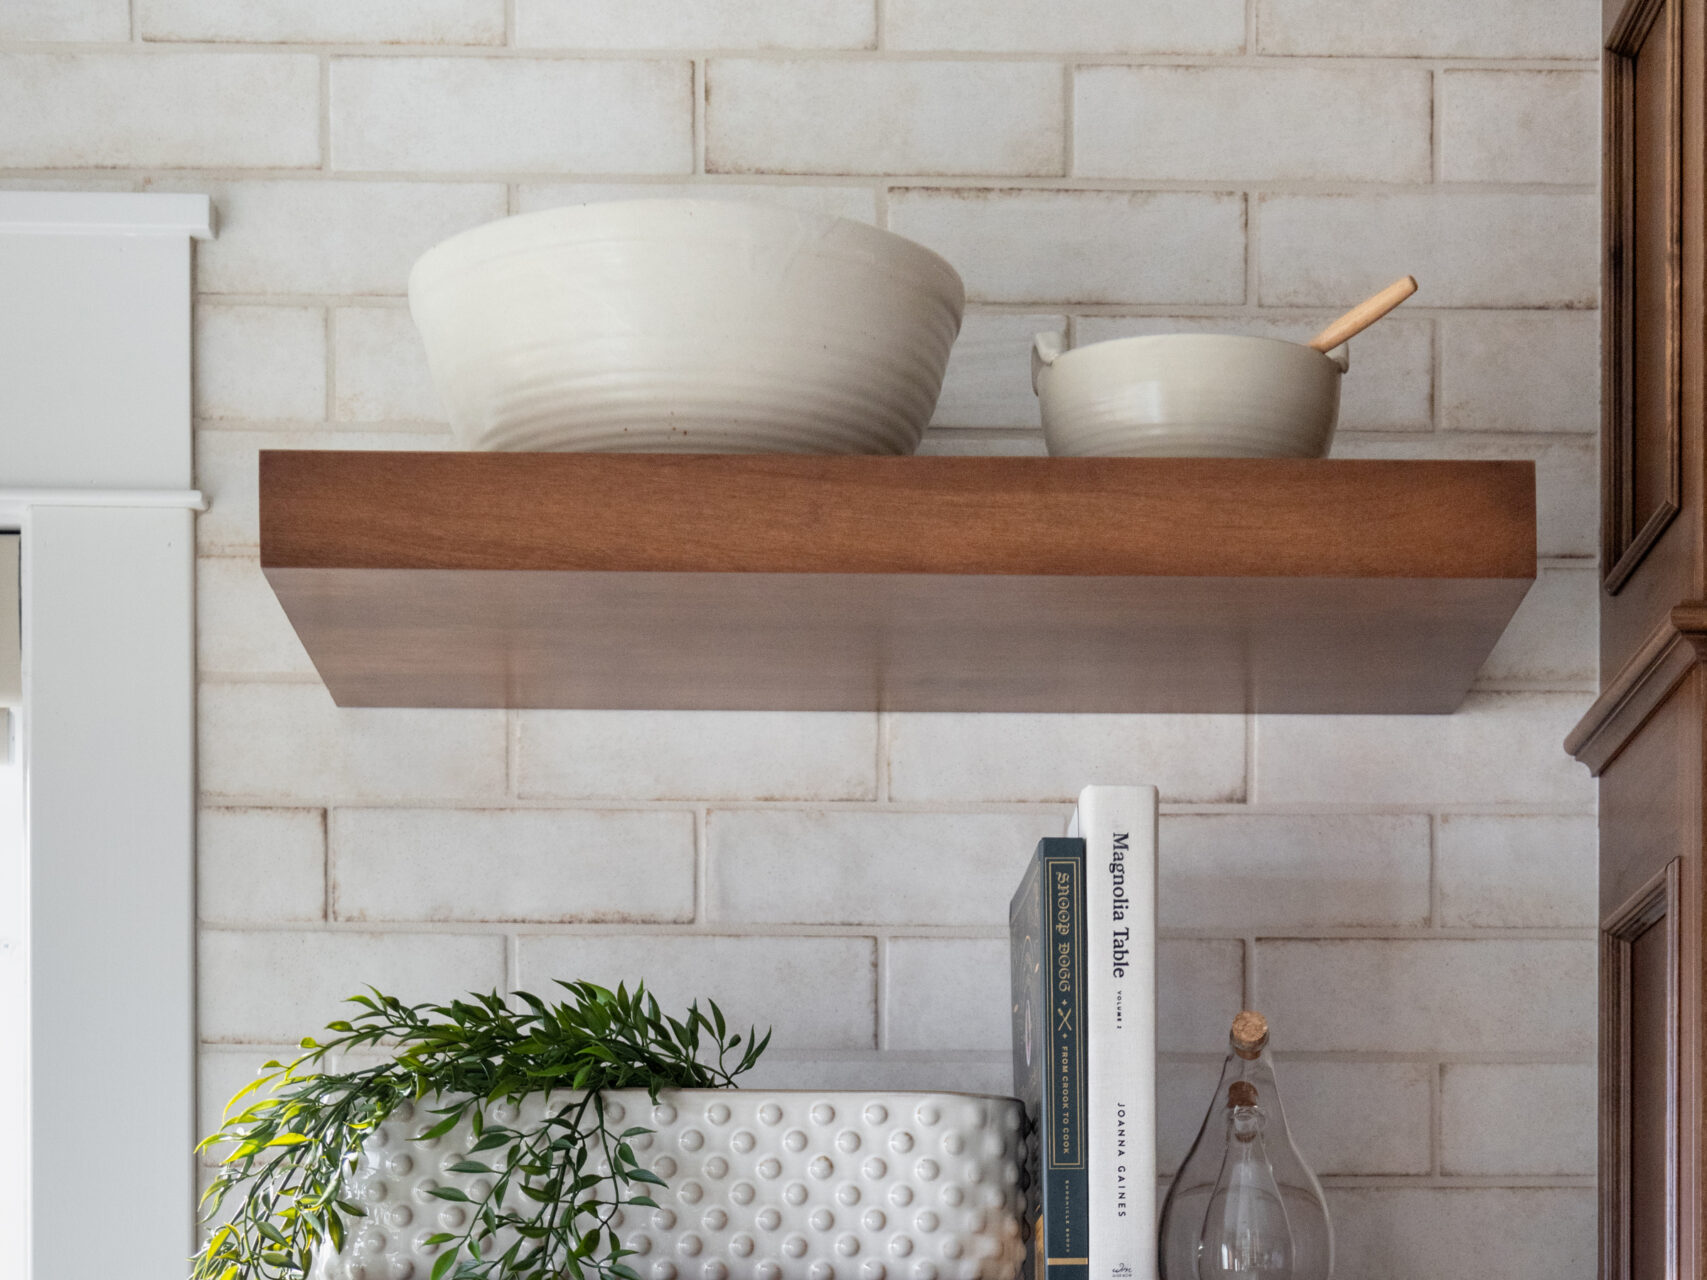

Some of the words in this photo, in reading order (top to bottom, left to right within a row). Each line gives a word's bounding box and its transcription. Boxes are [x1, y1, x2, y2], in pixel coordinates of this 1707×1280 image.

[1108, 832, 1129, 921] Magnolia
[1055, 871, 1070, 936] SNOOP
[1058, 942, 1071, 993] DOGG
[1112, 927, 1130, 979] Table
[1061, 1045, 1069, 1073] FROM
[1062, 1112, 1070, 1125] TO
[1117, 1102, 1126, 1157] JOANNA
[1117, 1165, 1127, 1218] GAINES
